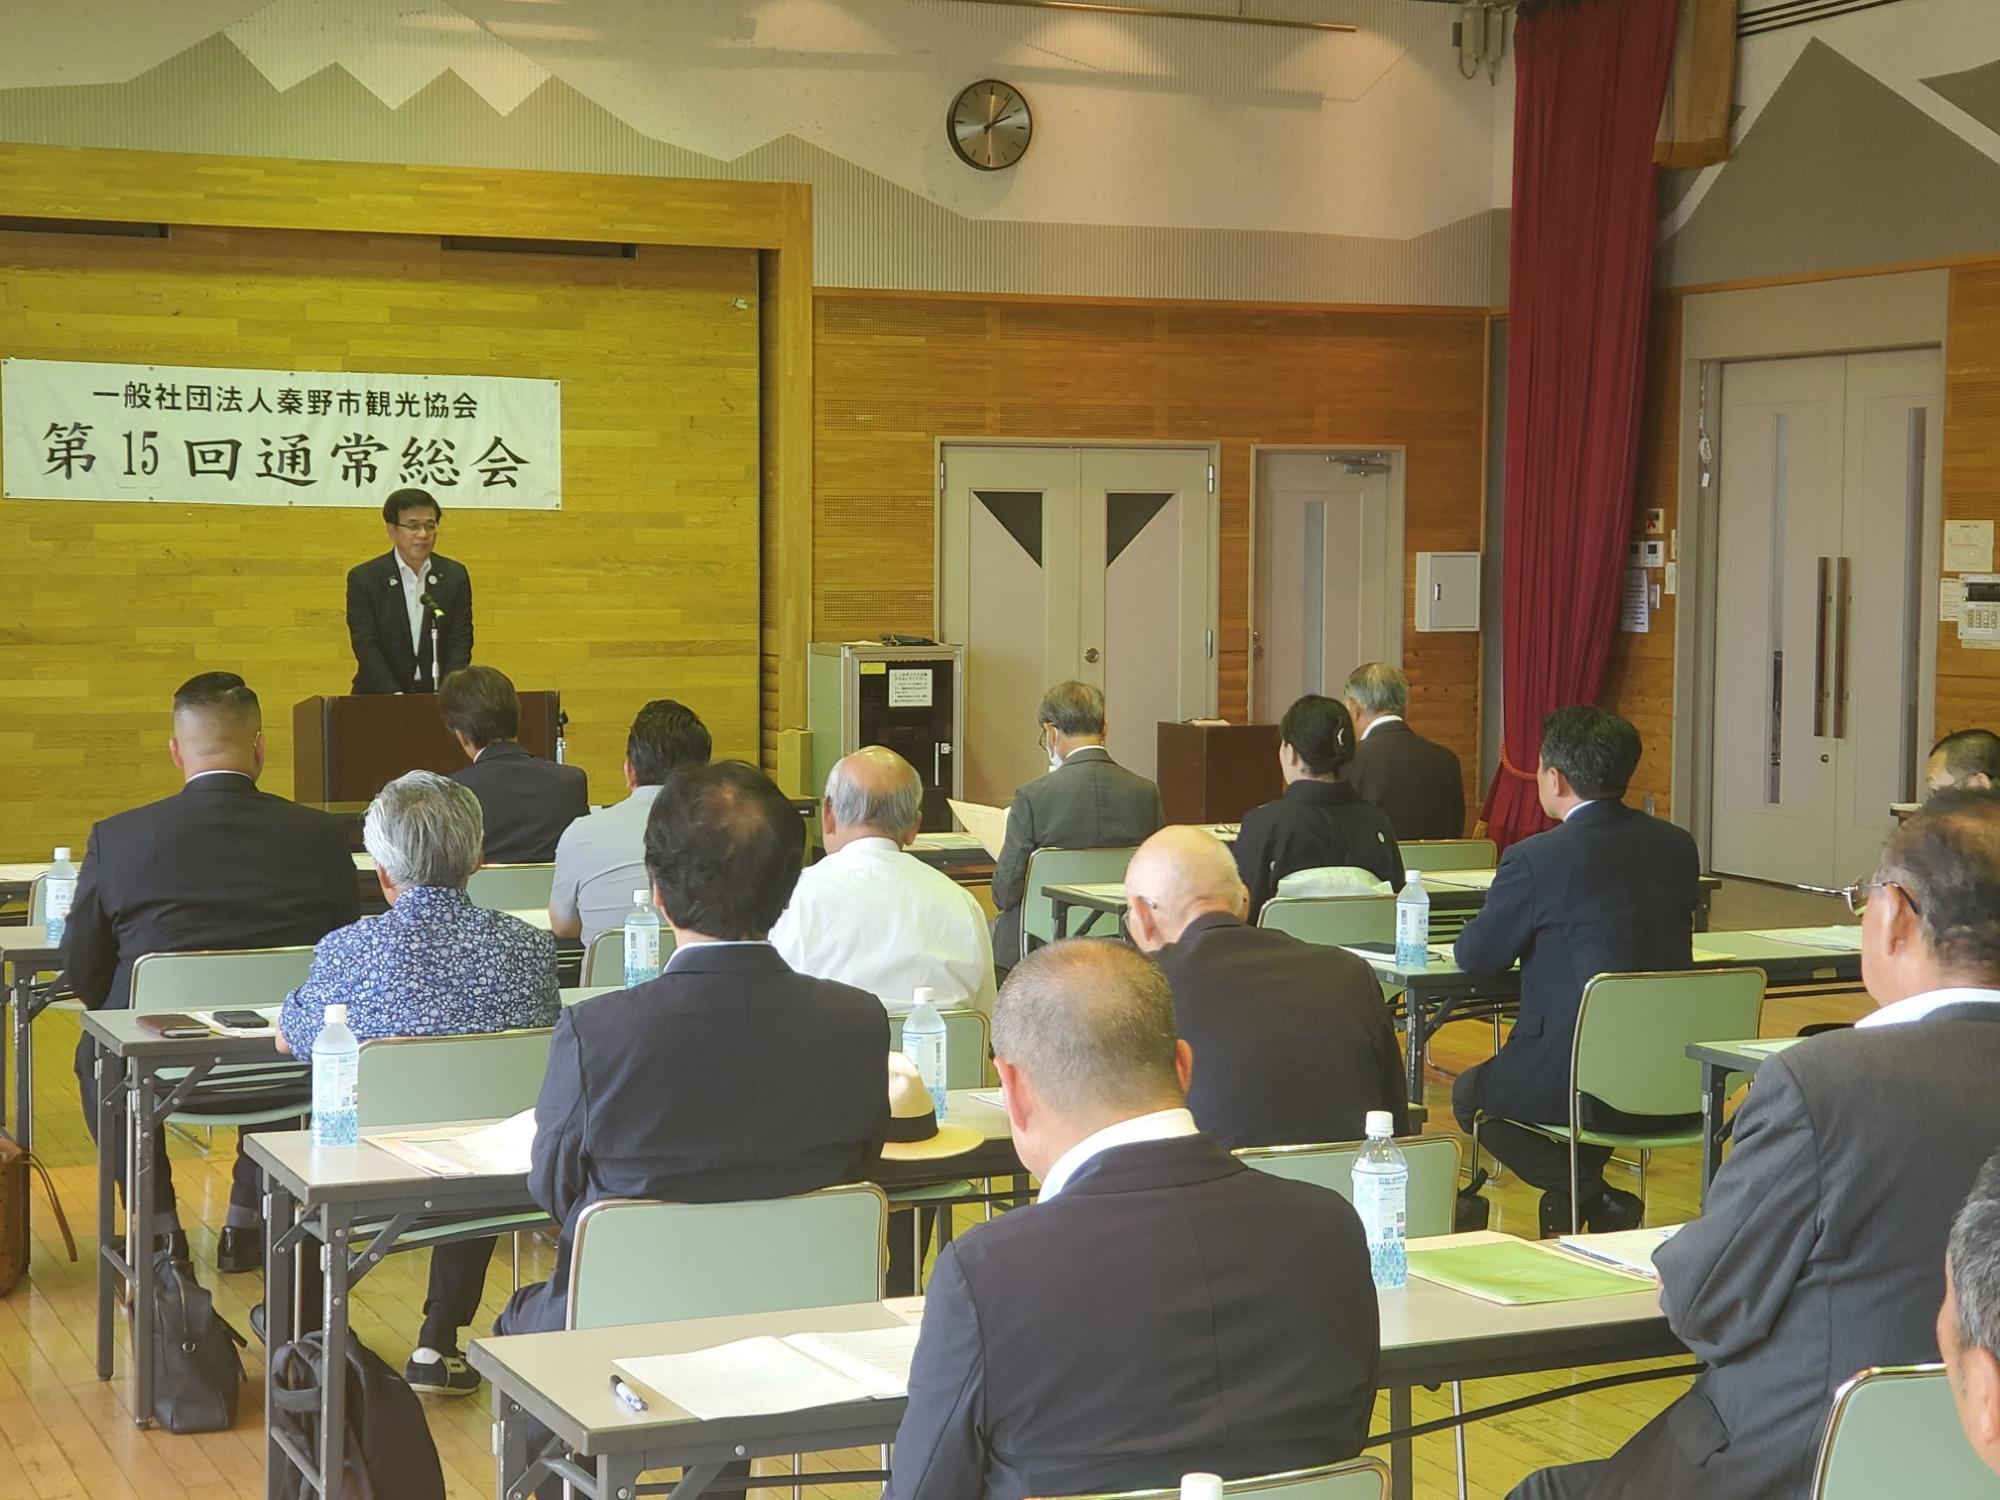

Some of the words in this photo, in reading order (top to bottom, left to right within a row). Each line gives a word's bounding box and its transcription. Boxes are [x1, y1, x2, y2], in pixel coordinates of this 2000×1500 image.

[93, 381, 478, 419] 一般社団法人秦野市観光協会
